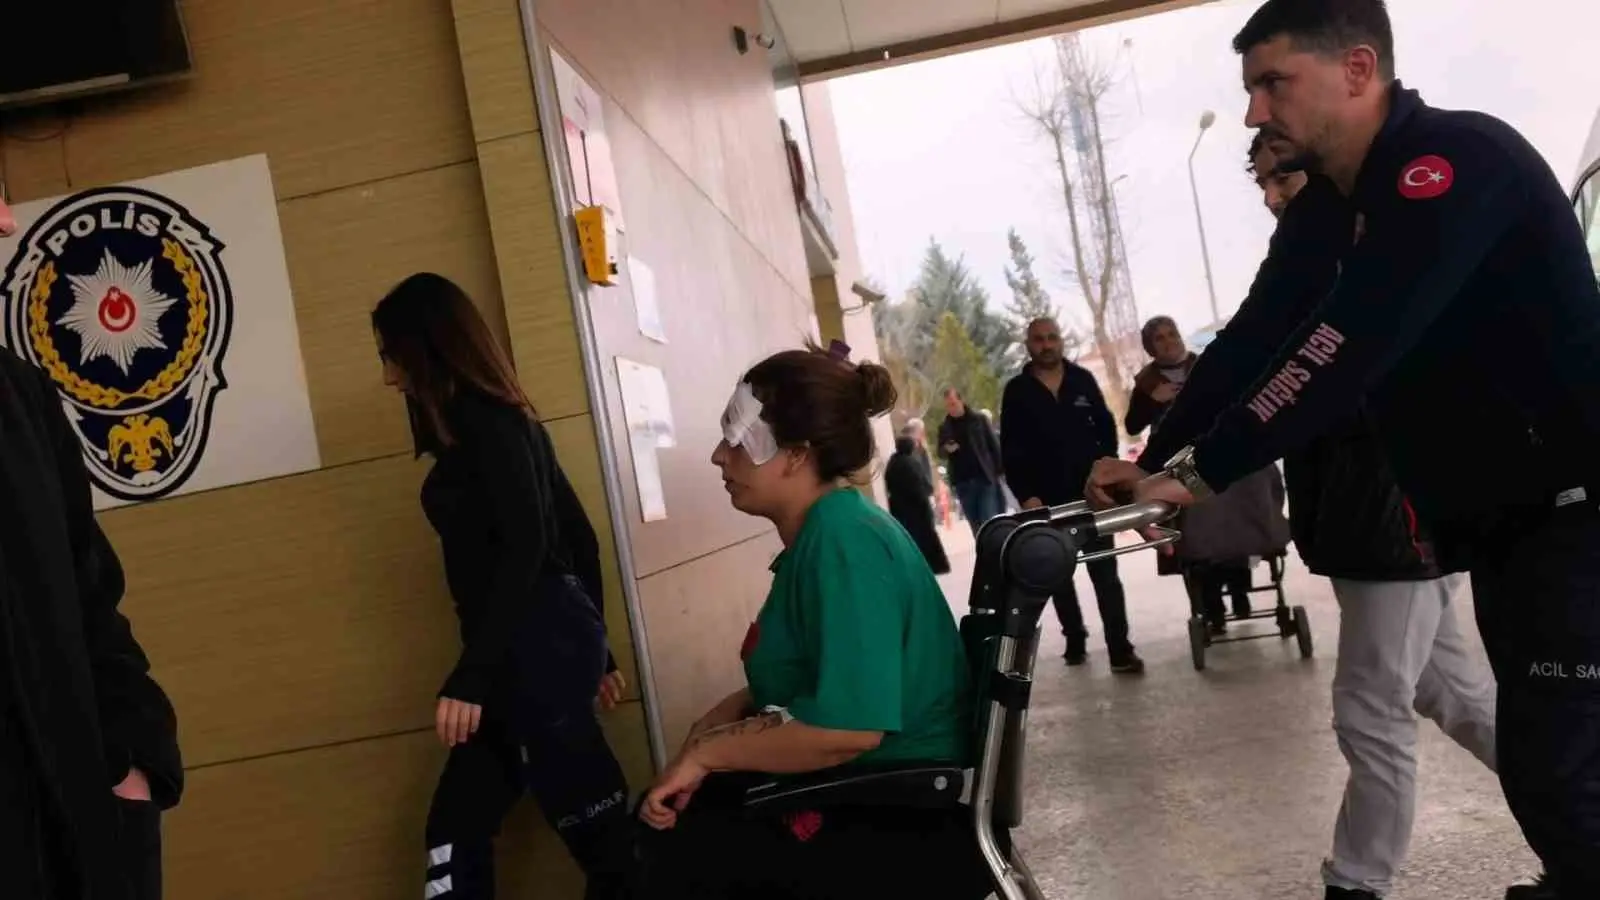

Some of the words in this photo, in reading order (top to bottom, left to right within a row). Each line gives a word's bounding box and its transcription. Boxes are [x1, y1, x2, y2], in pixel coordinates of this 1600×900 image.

[46, 202, 160, 256] POLİS
[1247, 360, 1311, 422] SAĞLIK
[1575, 664, 1600, 679] SA
